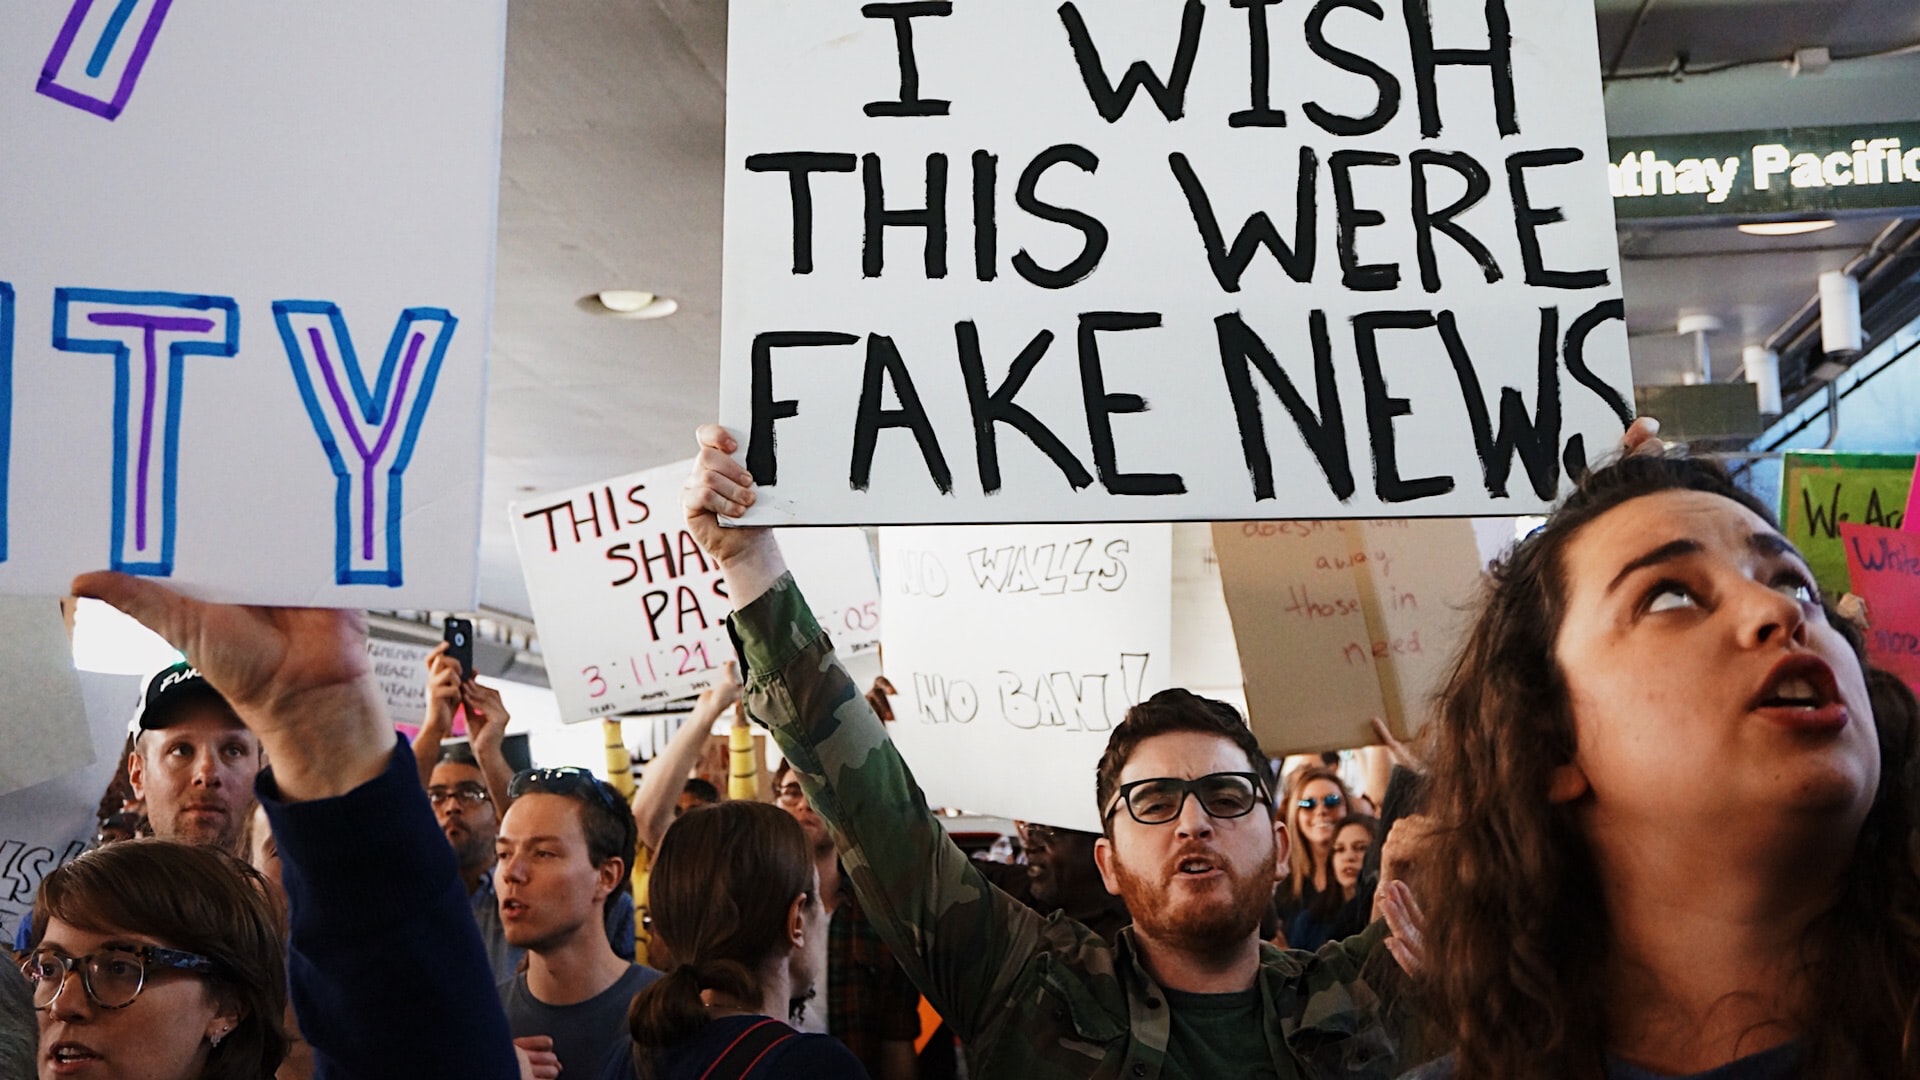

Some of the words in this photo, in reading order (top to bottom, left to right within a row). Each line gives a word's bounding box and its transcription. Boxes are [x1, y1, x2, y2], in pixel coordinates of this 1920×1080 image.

[861, 2, 952, 118] I
[1058, 0, 1521, 139] WISH
[745, 143, 1109, 289] THIS
[1168, 146, 1611, 293] WERE
[745, 311, 1189, 496] FAKE
[1214, 298, 1637, 503] NEWS
[0, 281, 459, 588] TY
[523, 484, 651, 552] THIS
[605, 529, 720, 587] SHA
[902, 549, 949, 597] NO
[967, 537, 1129, 596] WALLS
[1284, 584, 1360, 619] those
[1390, 586, 1417, 611] in
[1343, 631, 1422, 664] need
[913, 672, 978, 724] NO
